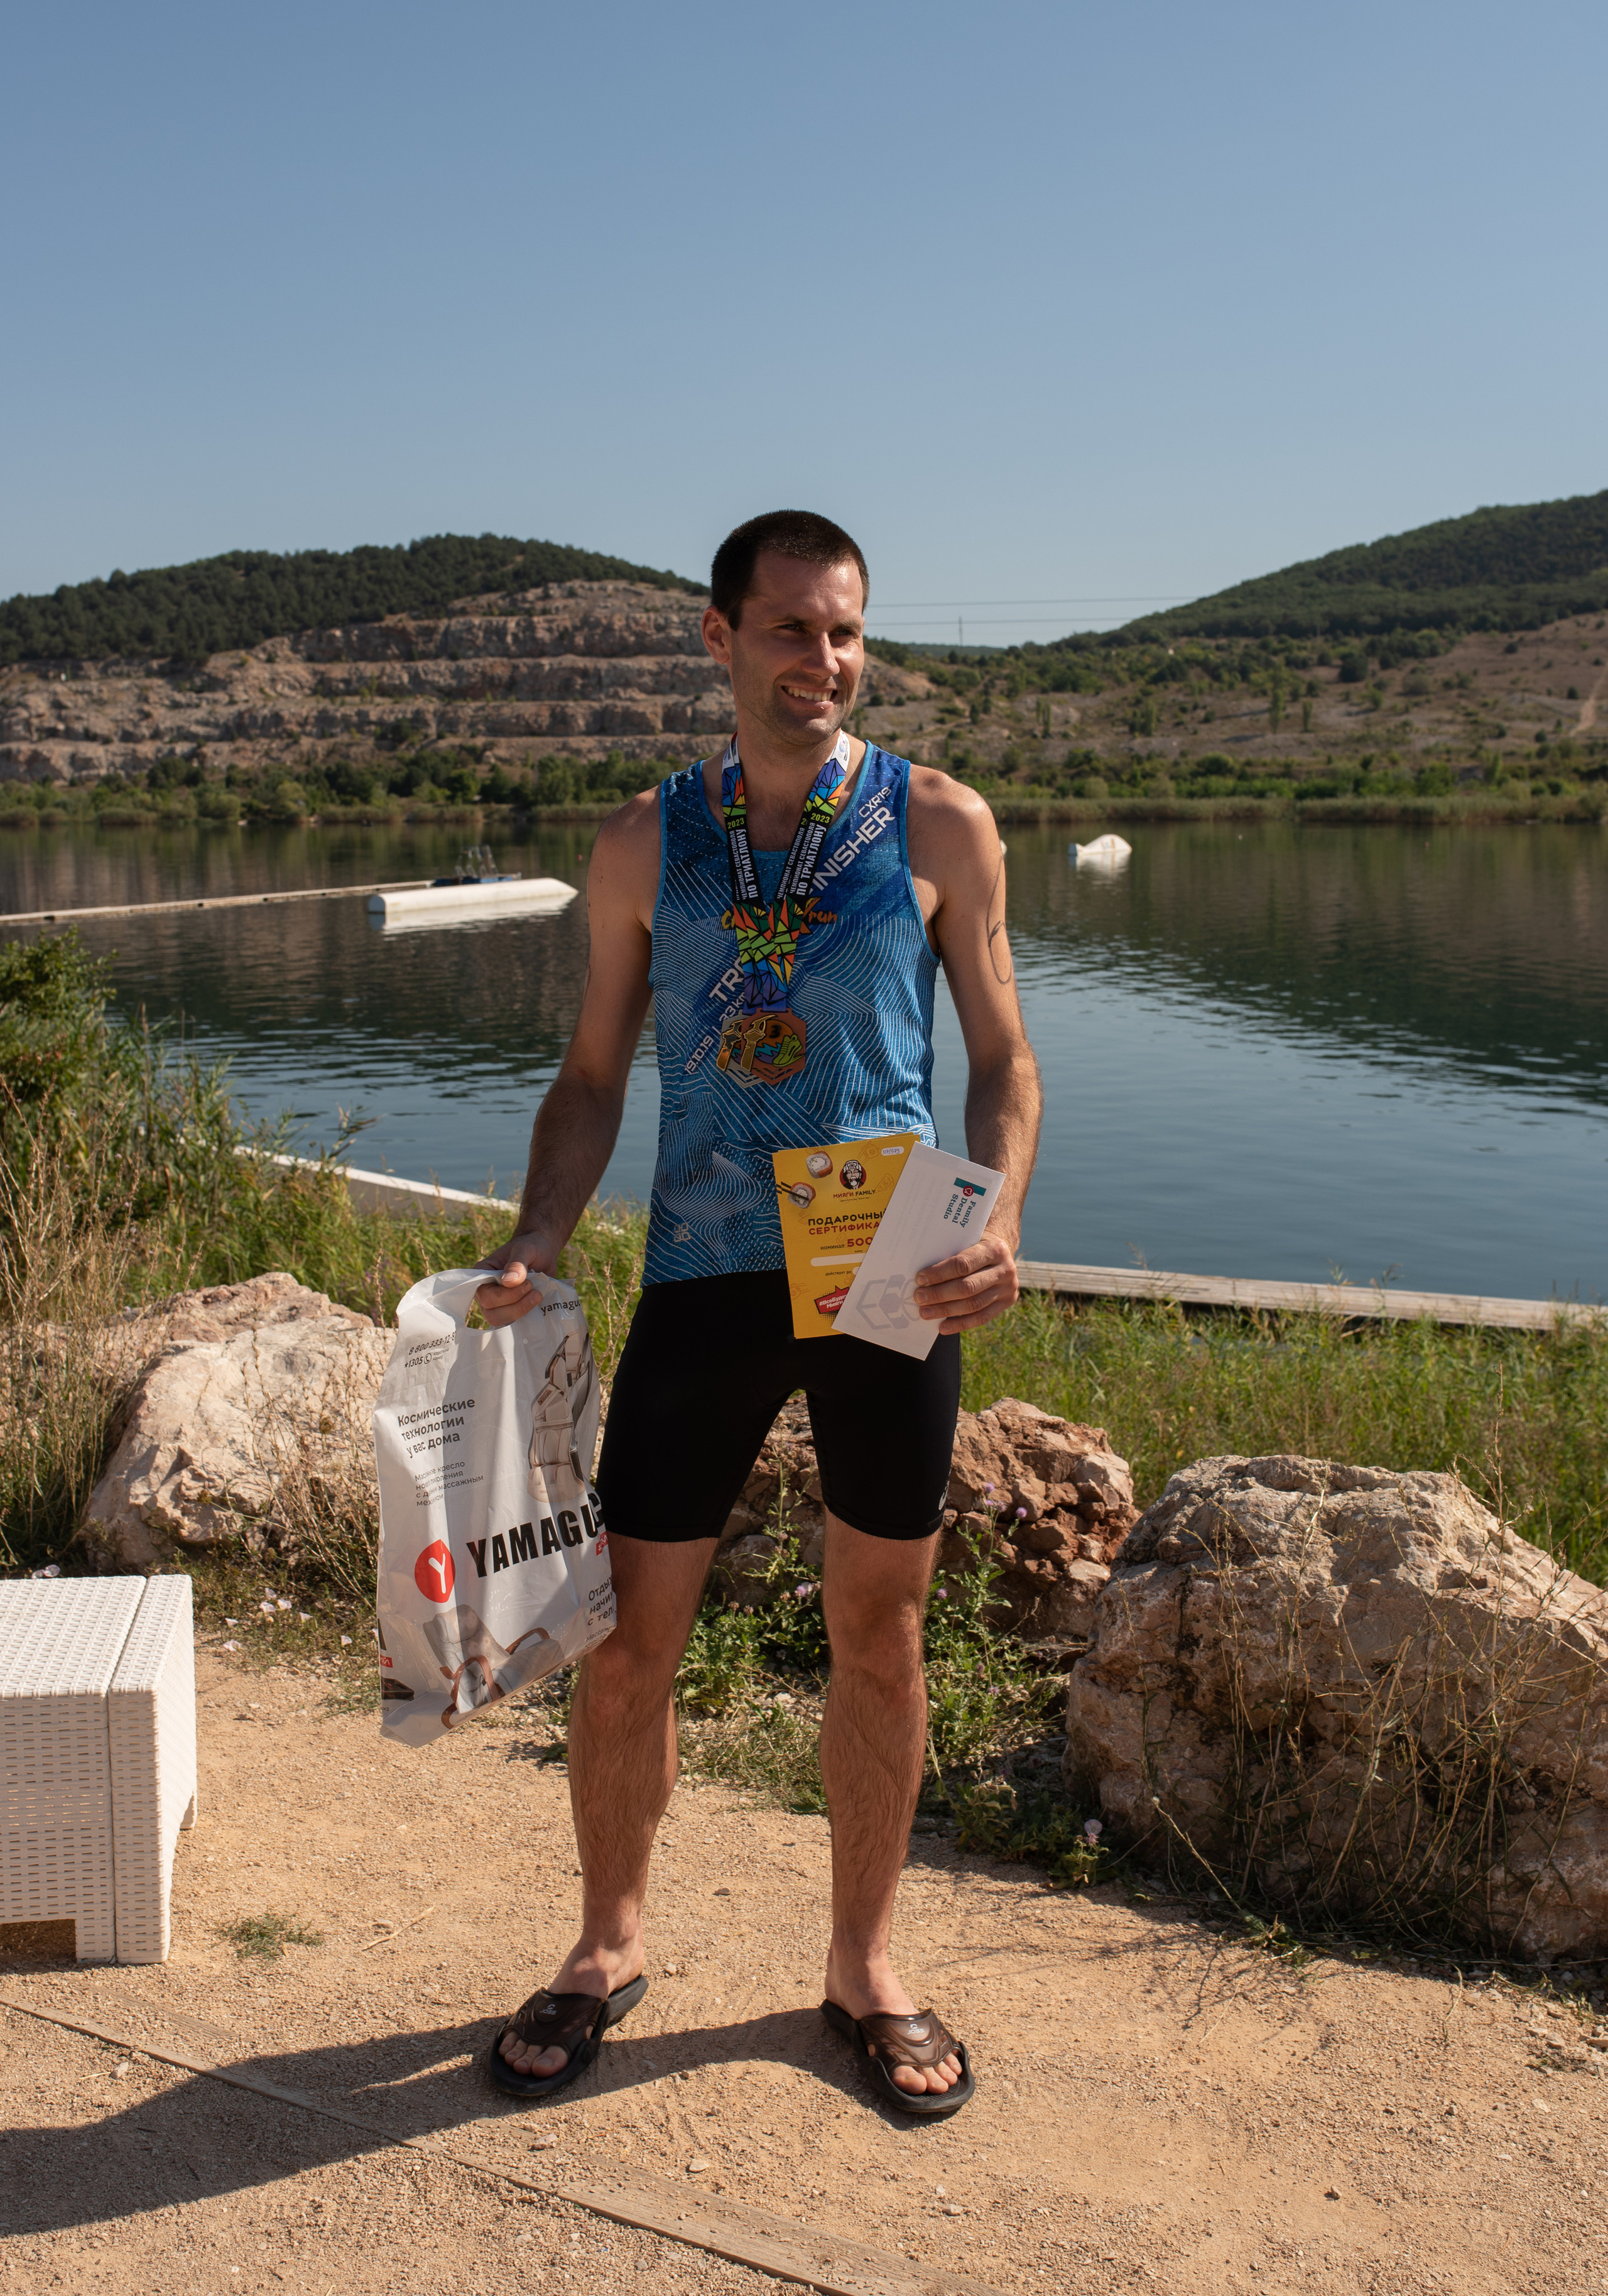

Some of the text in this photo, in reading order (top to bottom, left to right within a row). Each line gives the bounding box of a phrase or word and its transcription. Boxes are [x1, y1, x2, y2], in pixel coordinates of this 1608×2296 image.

[858, 786, 891, 818] CXR19
[727, 817, 745, 829] 2023
[810, 812, 830, 824] 2023
[729, 830, 741, 868] СЕВАСТОПОЛЯ
[790, 861, 803, 894] ЧЕМПИОНАТ
[799, 822, 815, 860] СЕВАСТОПОЛЯ
[800, 824, 827, 879] ТРИАТЛОНУ
[809, 807, 896, 895] INISHER
[736, 829, 759, 898] ПО ТРИАТЛОНУ
[776, 866, 791, 899] ЧЕМПИОНАТ
[788, 827, 805, 866] СЕВАСТОПОЛЯ
[736, 868, 747, 900] ЧЕМПИОНАТ
[796, 881, 808, 896] ПО
[943, 1194, 959, 1219] Studio
[952, 1197, 968, 1224] Dental
[959, 1200, 977, 1228] Family
[819, 1294, 847, 1306] #ВсеБуде
[408, 1347, 415, 1355] 8
[415, 1342, 429, 1353] 800
[398, 1398, 475, 1427] Космические
[401, 1416, 465, 1441] технологии
[406, 1432, 460, 1458] у вас дома
[437, 1461, 465, 1472] кресло
[438, 1475, 484, 1491] массажным
[597, 1605, 614, 1621] тел
